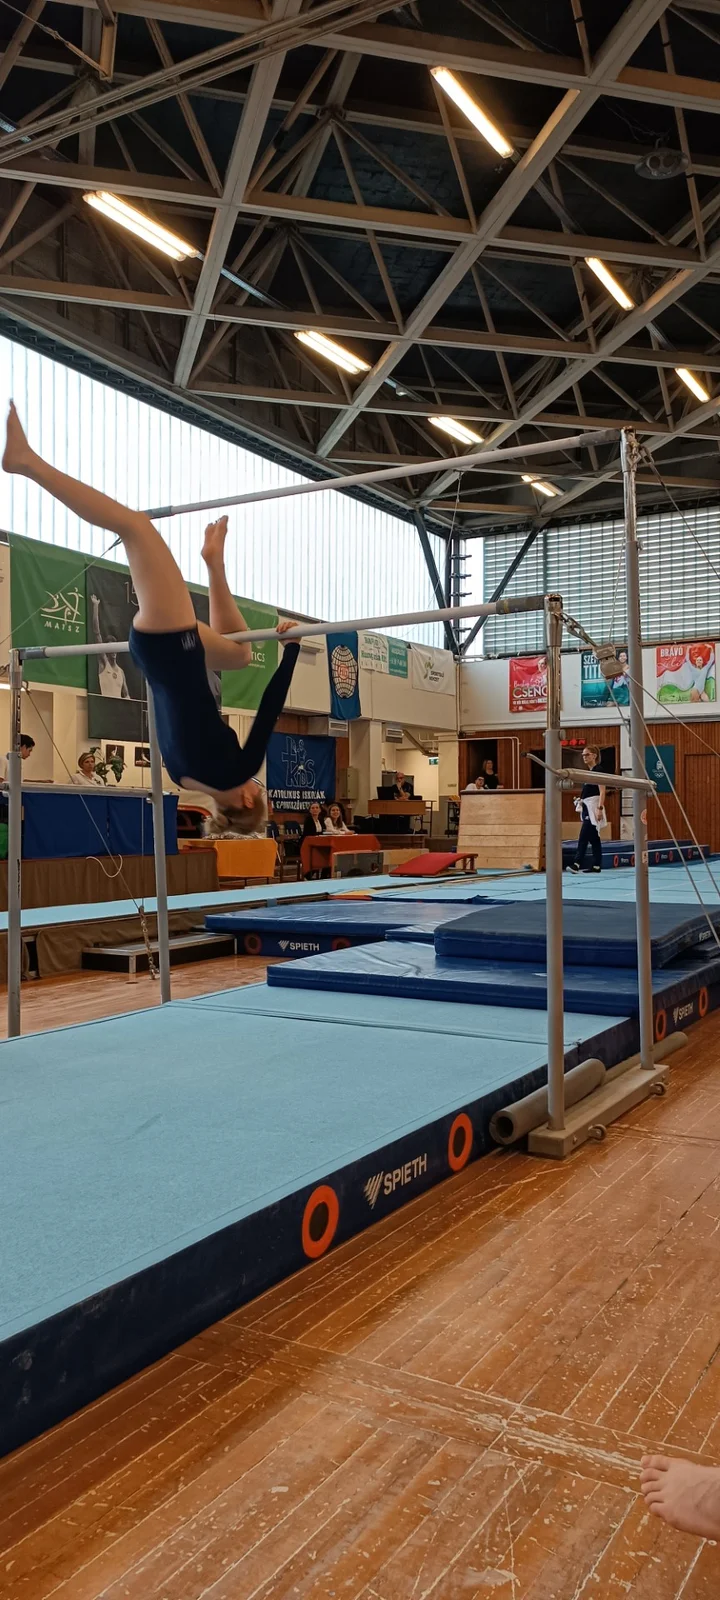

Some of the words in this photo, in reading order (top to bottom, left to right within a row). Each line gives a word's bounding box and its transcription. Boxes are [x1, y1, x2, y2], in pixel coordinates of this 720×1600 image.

[250, 651, 266, 663] TICS
[268, 789, 301, 800] KATOLIKUS
[289, 942, 320, 951] SPIETH
[678, 1001, 694, 1021] SPIETH
[383, 1152, 428, 1196] SPIETH
